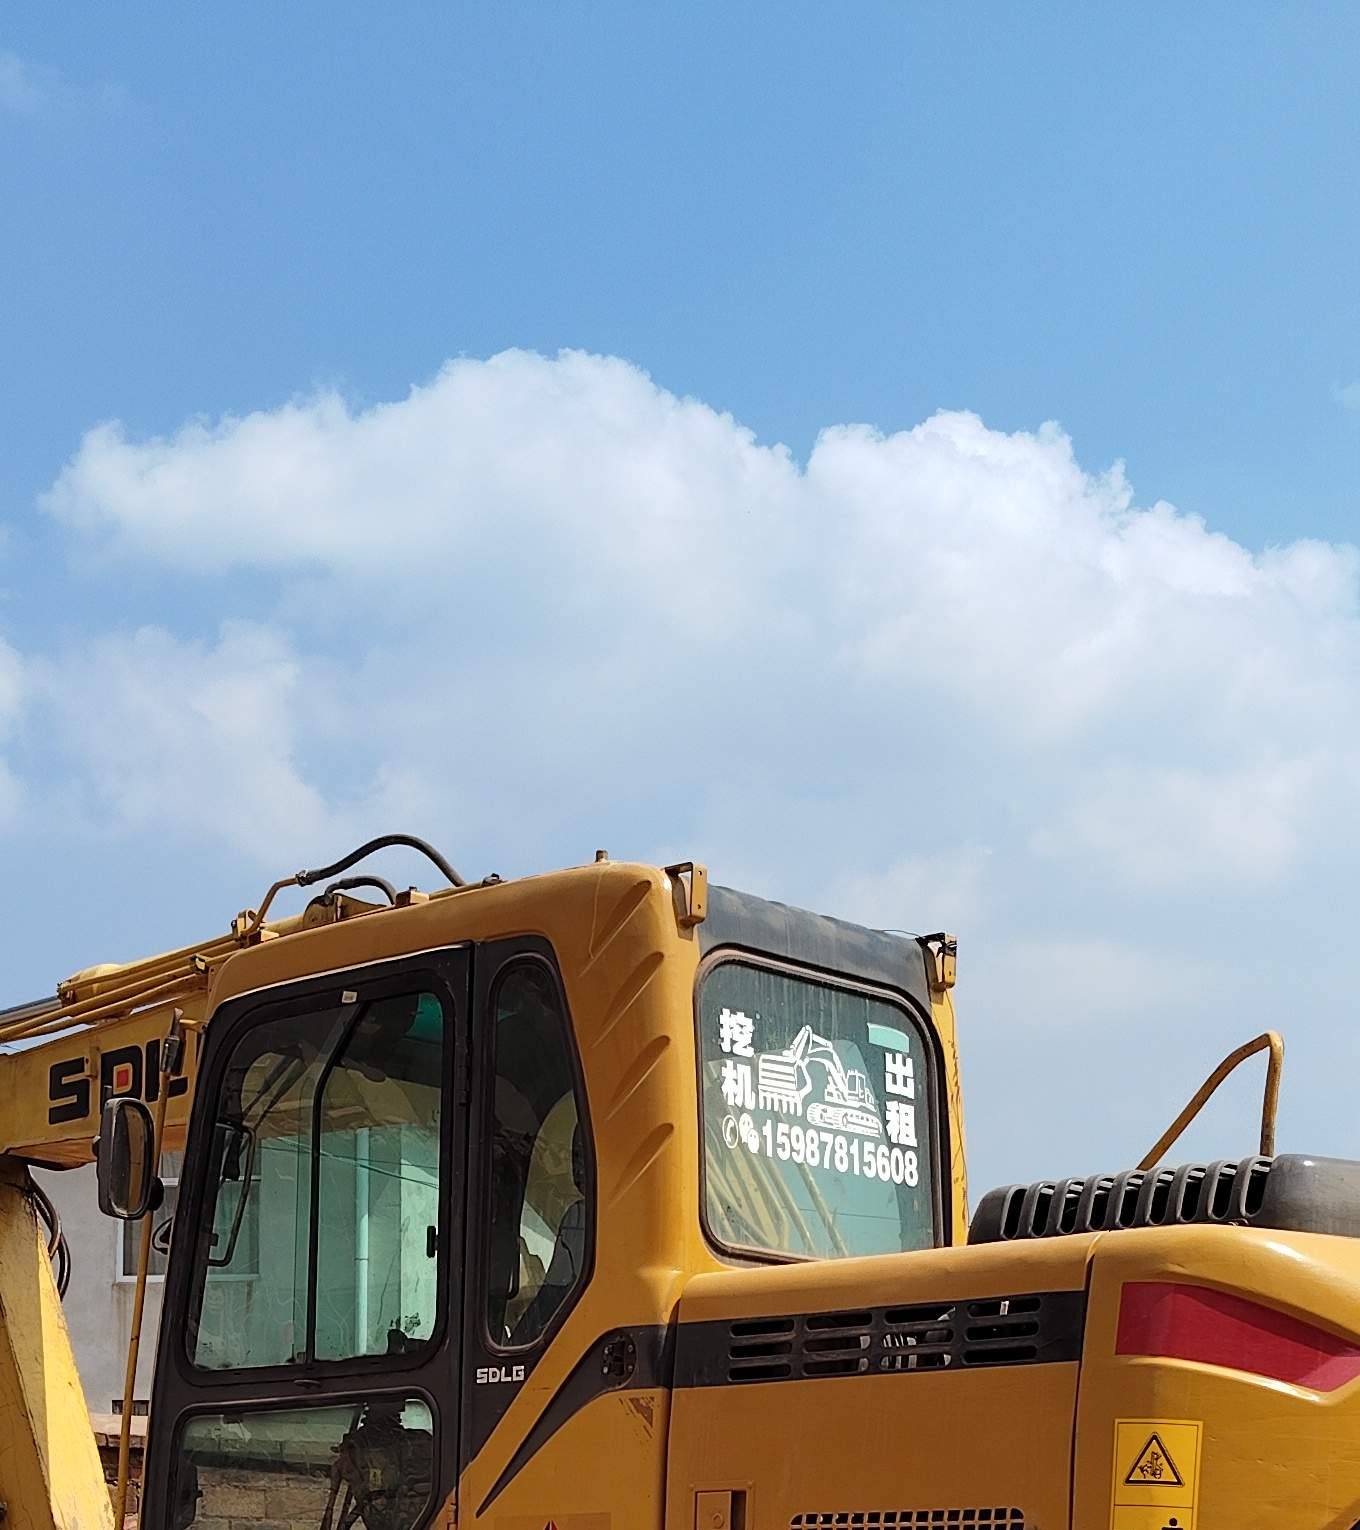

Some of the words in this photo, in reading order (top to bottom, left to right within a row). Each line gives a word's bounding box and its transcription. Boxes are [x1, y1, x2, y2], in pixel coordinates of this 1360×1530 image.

[49, 1031, 201, 1125] SDL
[719, 1008, 756, 1110] 挖机
[884, 1053, 918, 1148] 出租
[762, 1119, 919, 1188] 15987815608
[476, 1365, 525, 1384] SDLG
